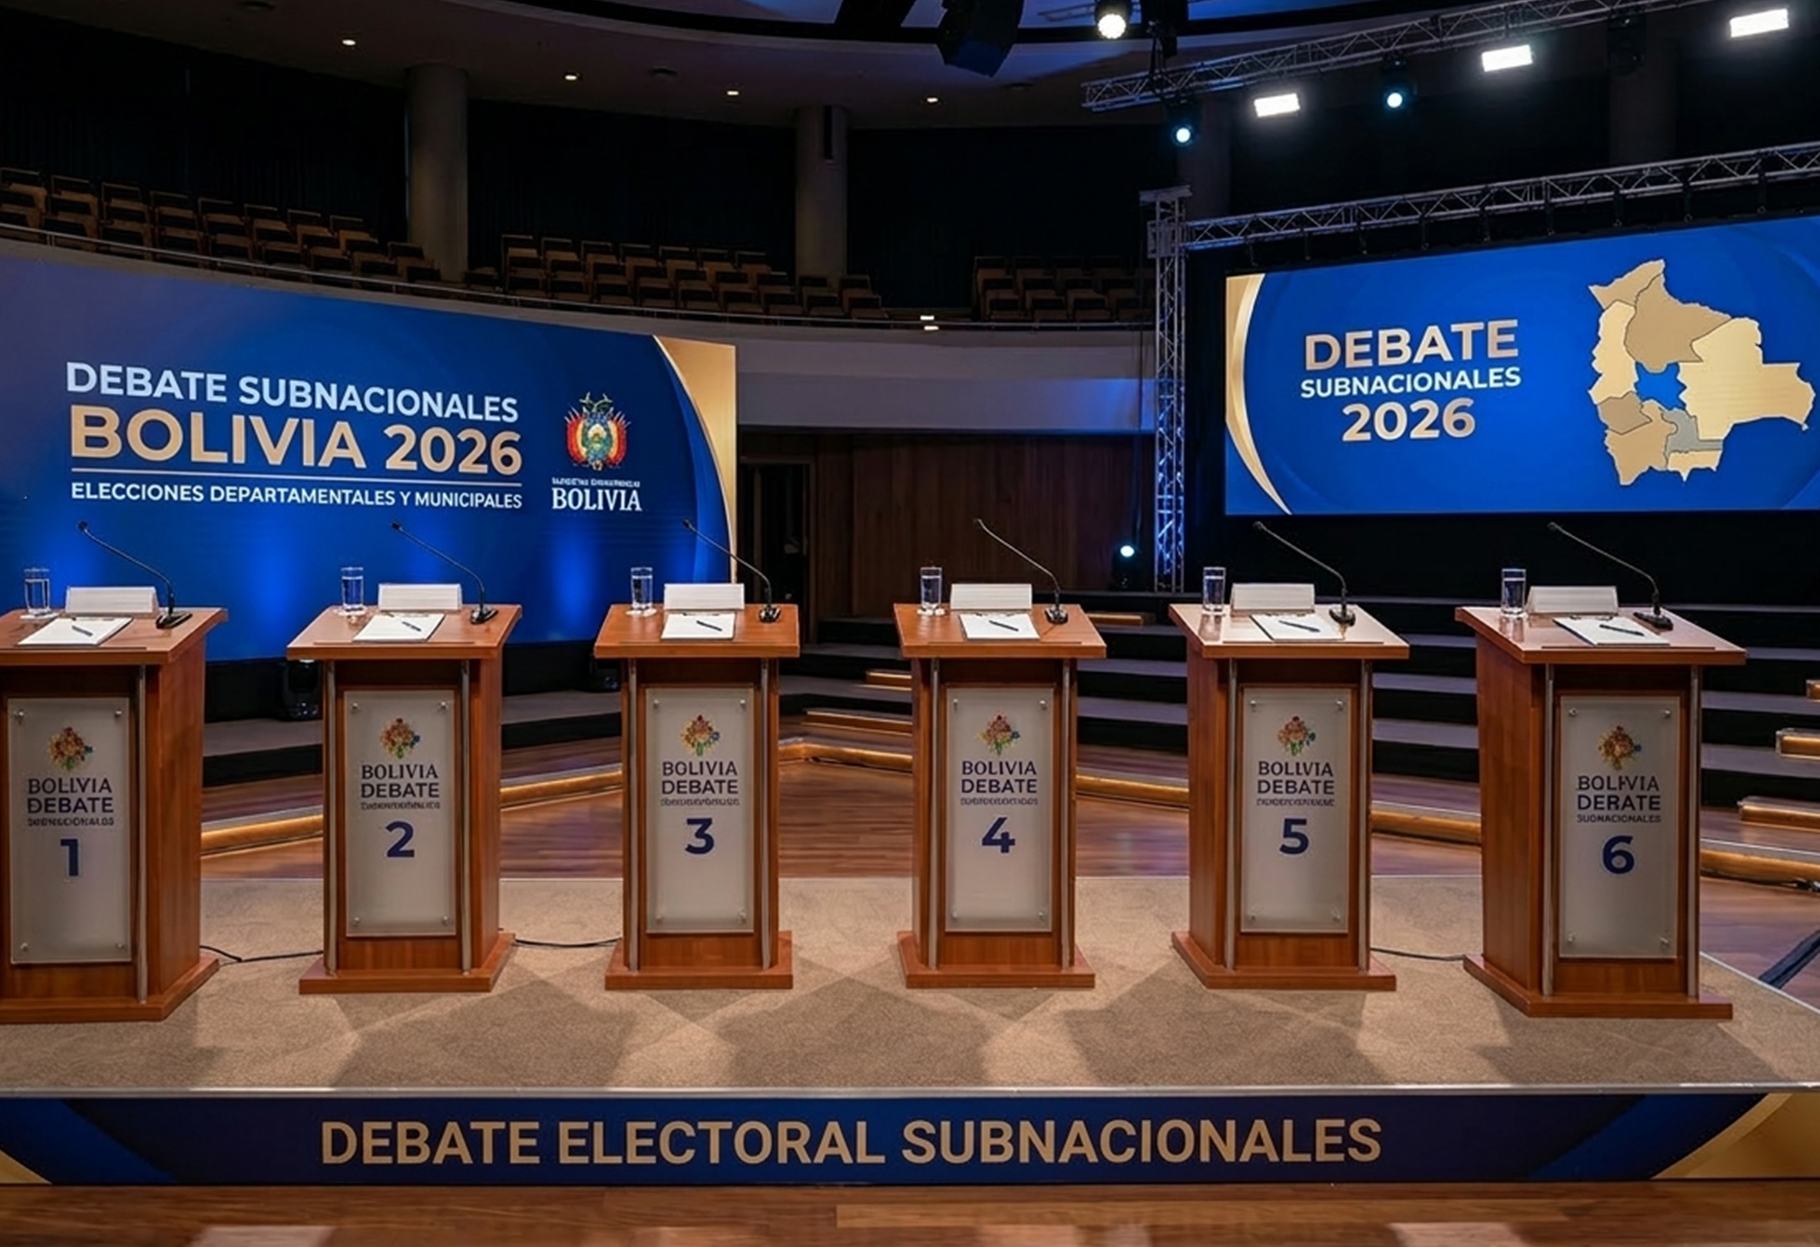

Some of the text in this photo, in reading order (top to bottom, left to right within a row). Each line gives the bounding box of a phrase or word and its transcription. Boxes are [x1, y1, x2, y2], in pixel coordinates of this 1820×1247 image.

[1306, 319, 1519, 370] DEBATE
[66, 361, 519, 423] DEBATE SUBNACIONALES
[1300, 366, 1522, 398] SUBNACIONALES
[1342, 397, 1476, 442] 2026
[70, 404, 523, 476] BOLIVIA 2026
[71, 482, 523, 509] ELECCIONES DEPARTAMENTALES Y MUNICIPALES
[551, 487, 643, 512] BOLIVIA
[361, 764, 439, 780] BOLIVIA
[961, 779, 1037, 793] DEBATE
[962, 761, 1037, 775] BOLIVIA
[27, 797, 114, 814] DEBATE
[361, 783, 440, 798] DEBATE
[661, 780, 739, 795] DEBATE
[1257, 780, 1335, 795] DEBATE
[385, 820, 415, 858] 2
[685, 817, 715, 855] 3
[981, 816, 1016, 854] 4
[1279, 817, 1310, 855] 5
[60, 838, 79, 877] 1
[1602, 835, 1635, 875] 6
[321, 1118, 1383, 1165] DEBATE ELECTORAL SUBNACIONALES
